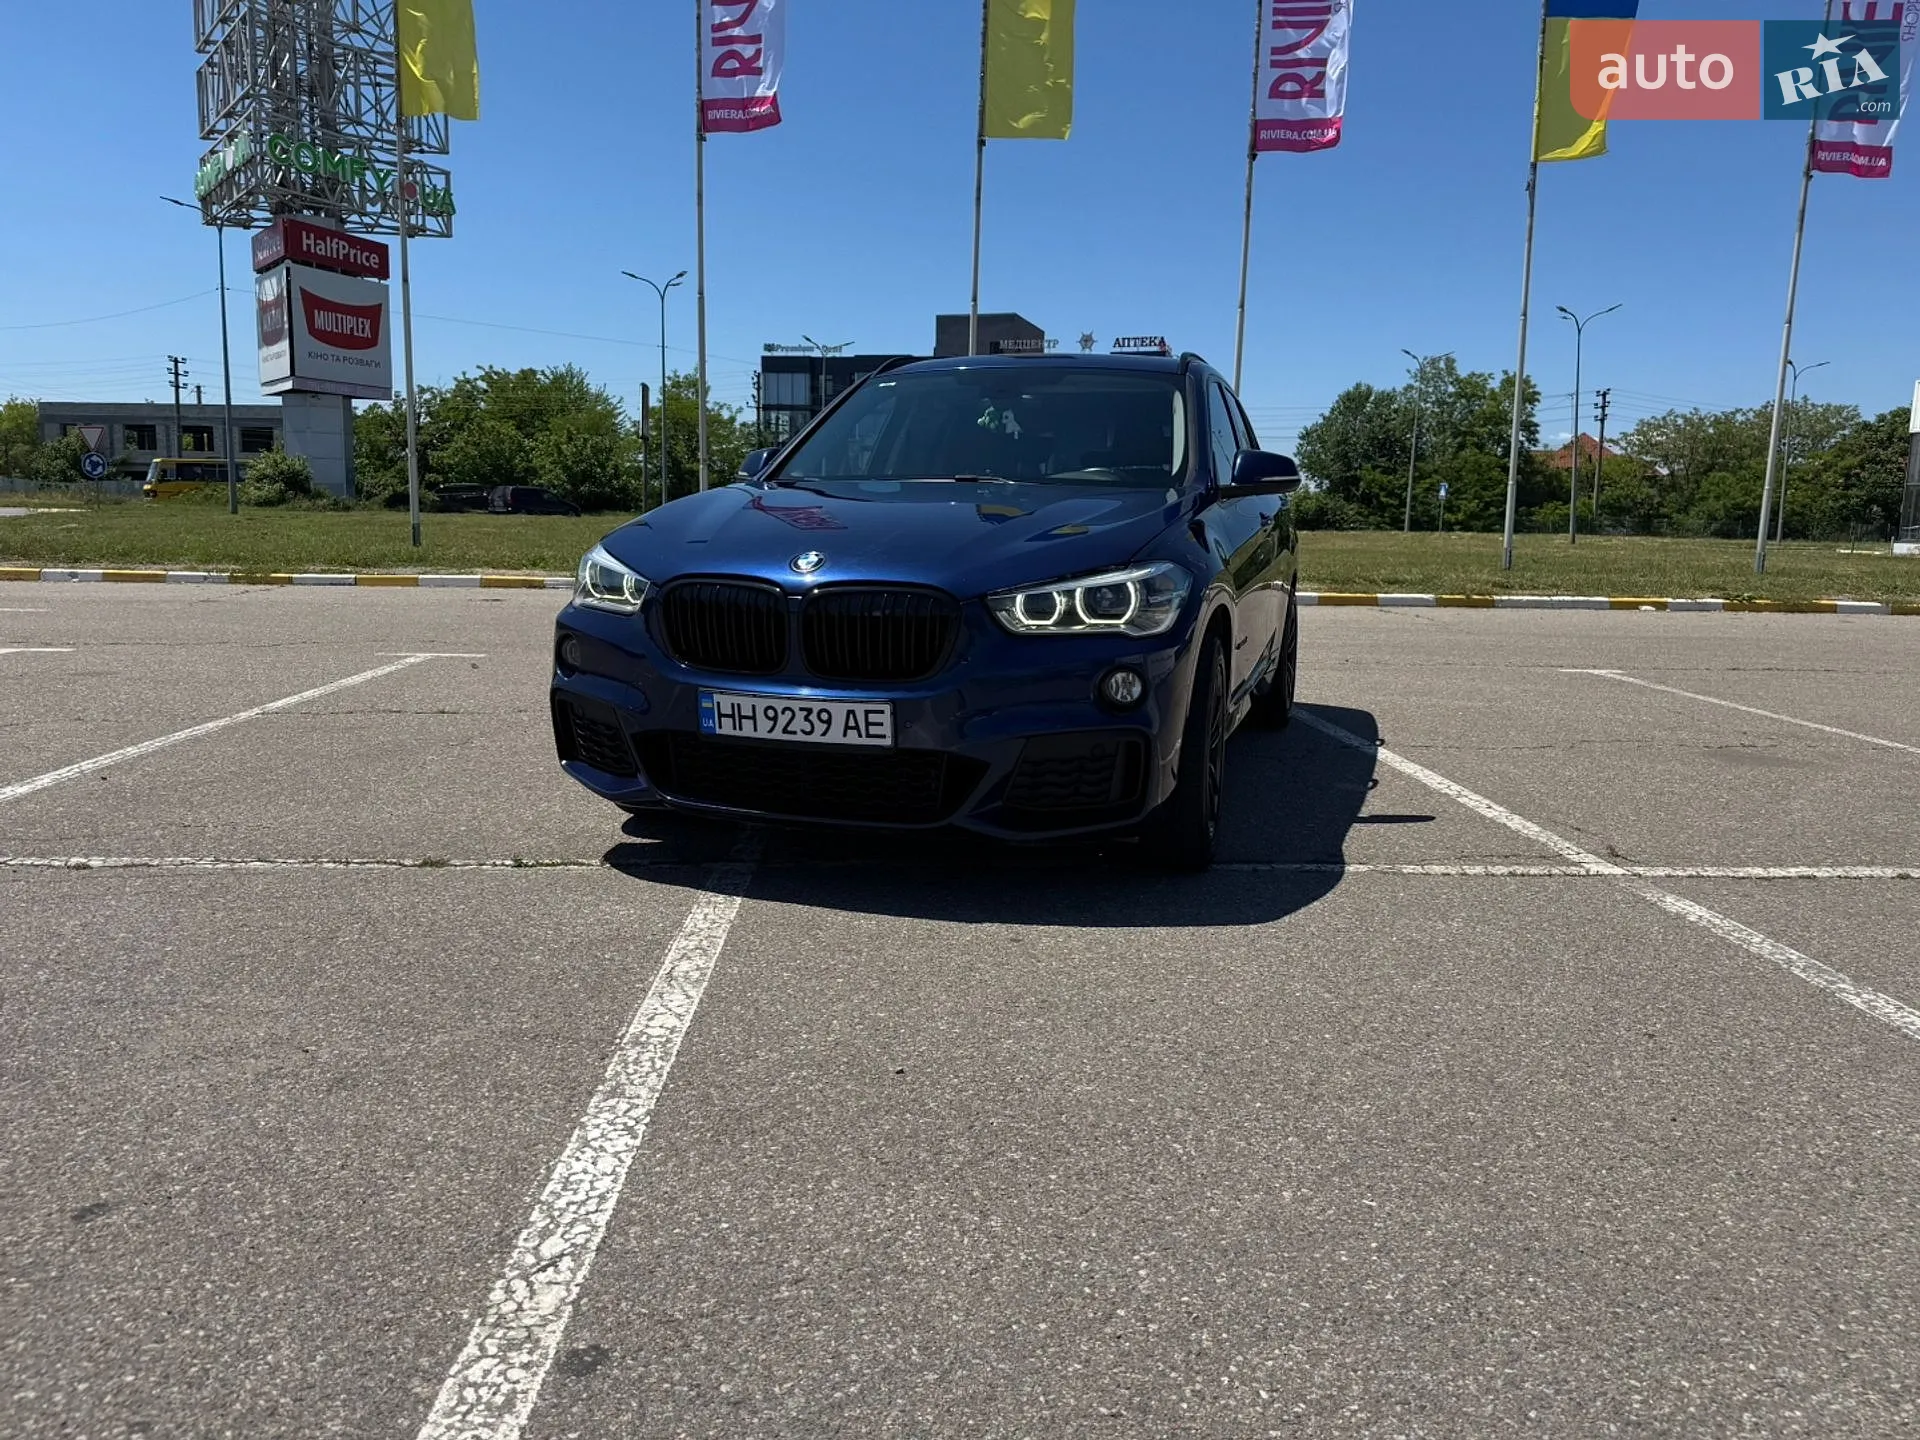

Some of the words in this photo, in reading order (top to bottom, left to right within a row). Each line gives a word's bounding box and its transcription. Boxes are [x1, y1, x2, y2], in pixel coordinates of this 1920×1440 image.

[1268, 0, 1331, 99] RIVI
[1260, 127, 1337, 140] RIVIERA.COM.UA
[301, 230, 380, 269] HalfPrice
[314, 309, 372, 339] MULTIPLEX
[999, 339, 1060, 350] МЕДЦЕНТР
[1112, 336, 1166, 348] АПТЕКА
[330, 354, 342, 364] ТА
[342, 356, 381, 369] РОЗВАГИ
[716, 701, 757, 732] HH
[763, 706, 833, 737] 9239
[843, 709, 887, 739] AE
